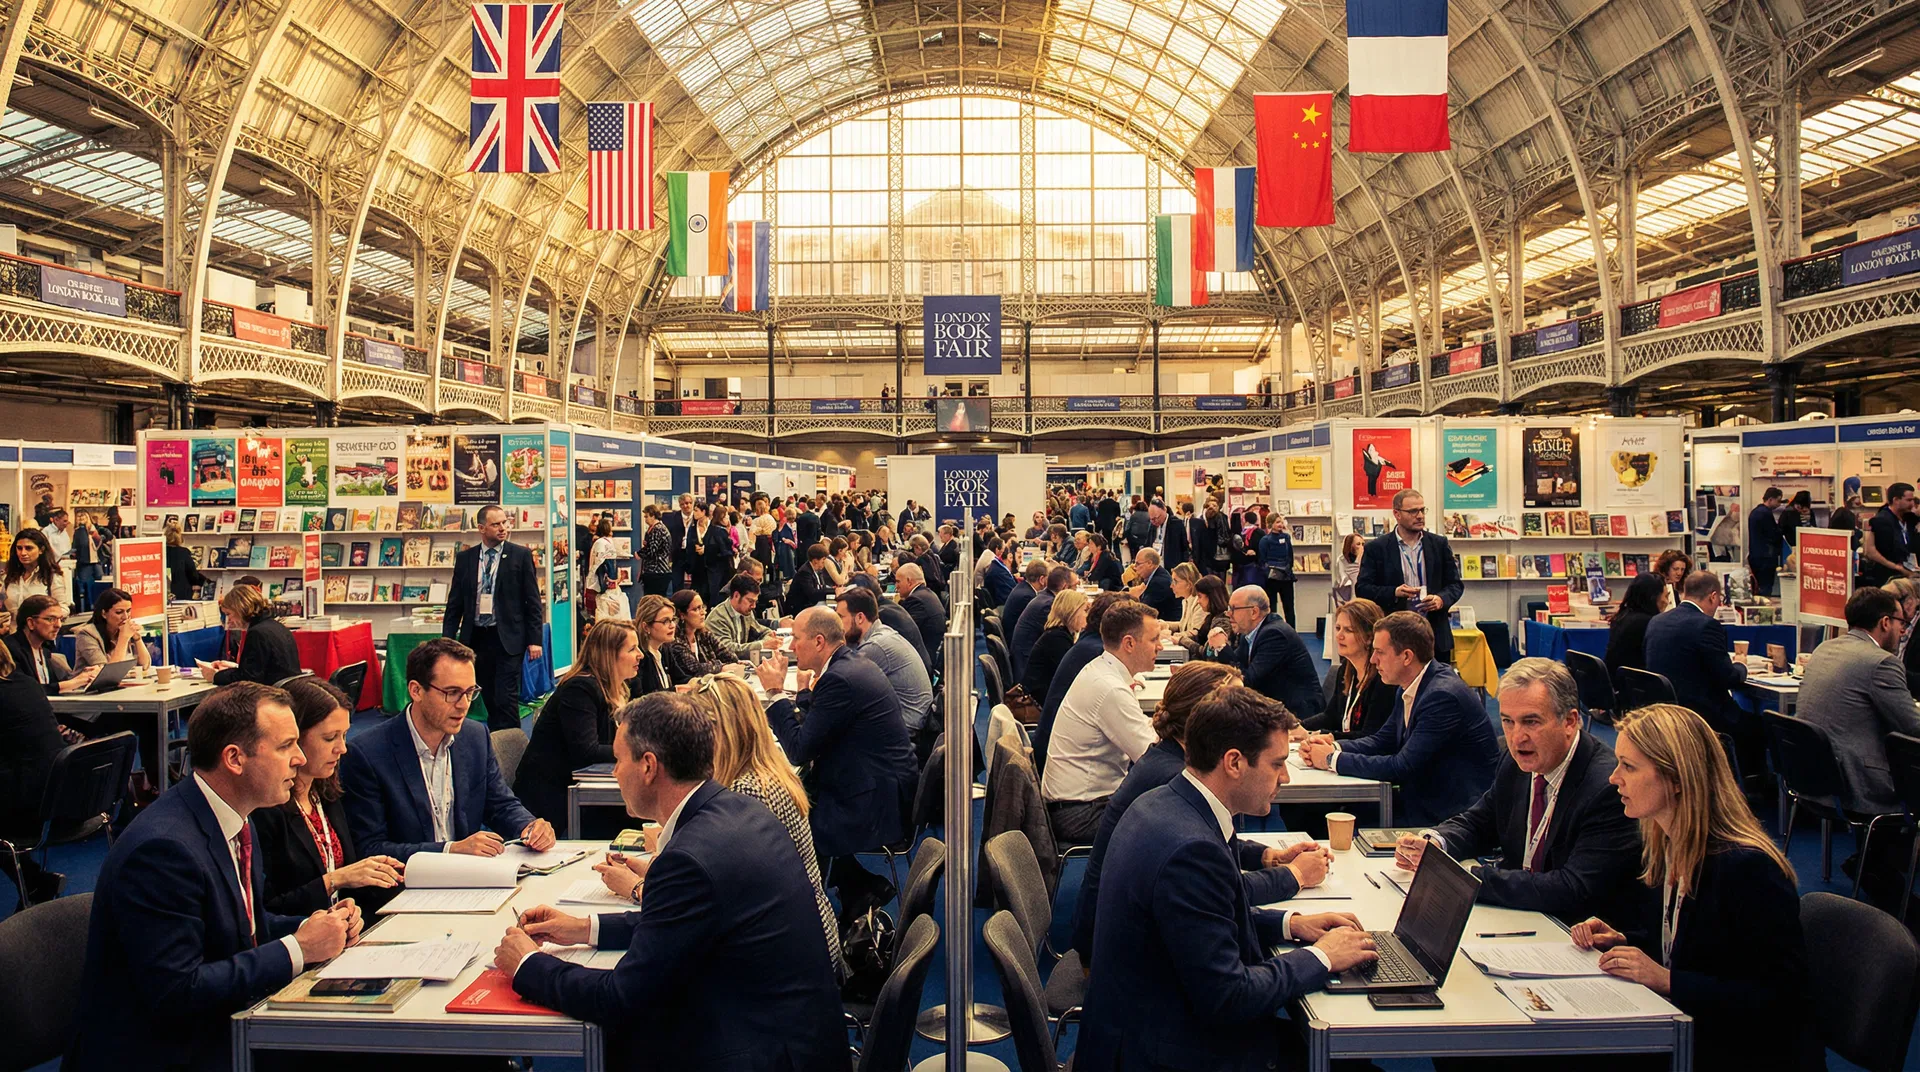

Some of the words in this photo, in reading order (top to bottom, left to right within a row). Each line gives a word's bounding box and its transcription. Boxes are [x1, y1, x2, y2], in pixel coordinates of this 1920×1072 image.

[1851, 257, 1884, 274] LONDON
[1885, 251, 1910, 266] BOOK
[934, 312, 991, 323] LONDON
[934, 323, 992, 339] BOOK
[933, 339, 992, 358] FAIR
[943, 469, 990, 479] LONDON
[944, 478, 991, 493] BOOK
[943, 492, 990, 507] FAIR
